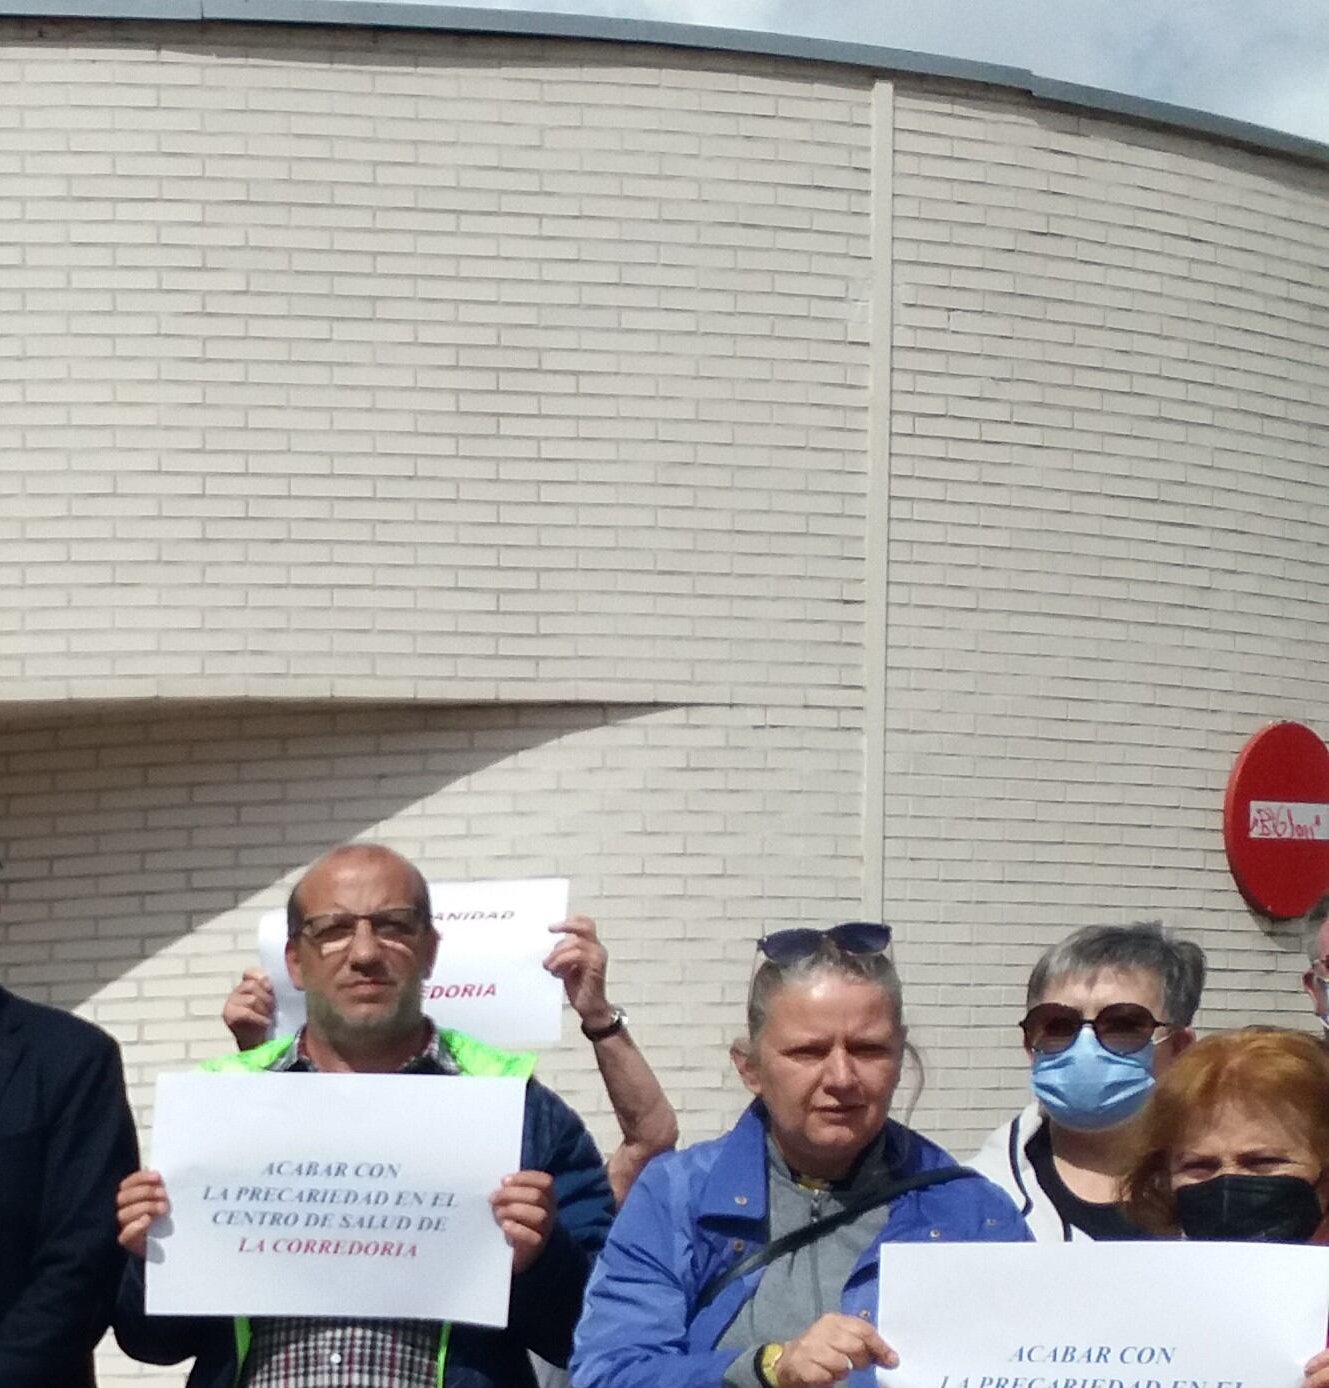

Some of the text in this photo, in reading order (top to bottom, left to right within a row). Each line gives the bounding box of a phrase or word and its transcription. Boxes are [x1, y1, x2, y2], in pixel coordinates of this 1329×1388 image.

[433, 911, 515, 921] ANIDAD
[263, 1161, 401, 1178] ACABAR CON
[203, 1185, 458, 1208] LA PRECARIEDAD EN EL
[212, 1210, 449, 1232] CENTRO DE SALUD DE
[238, 1237, 418, 1257] LA CORREDORIA
[1008, 1345, 1177, 1365] ACABAR CON
